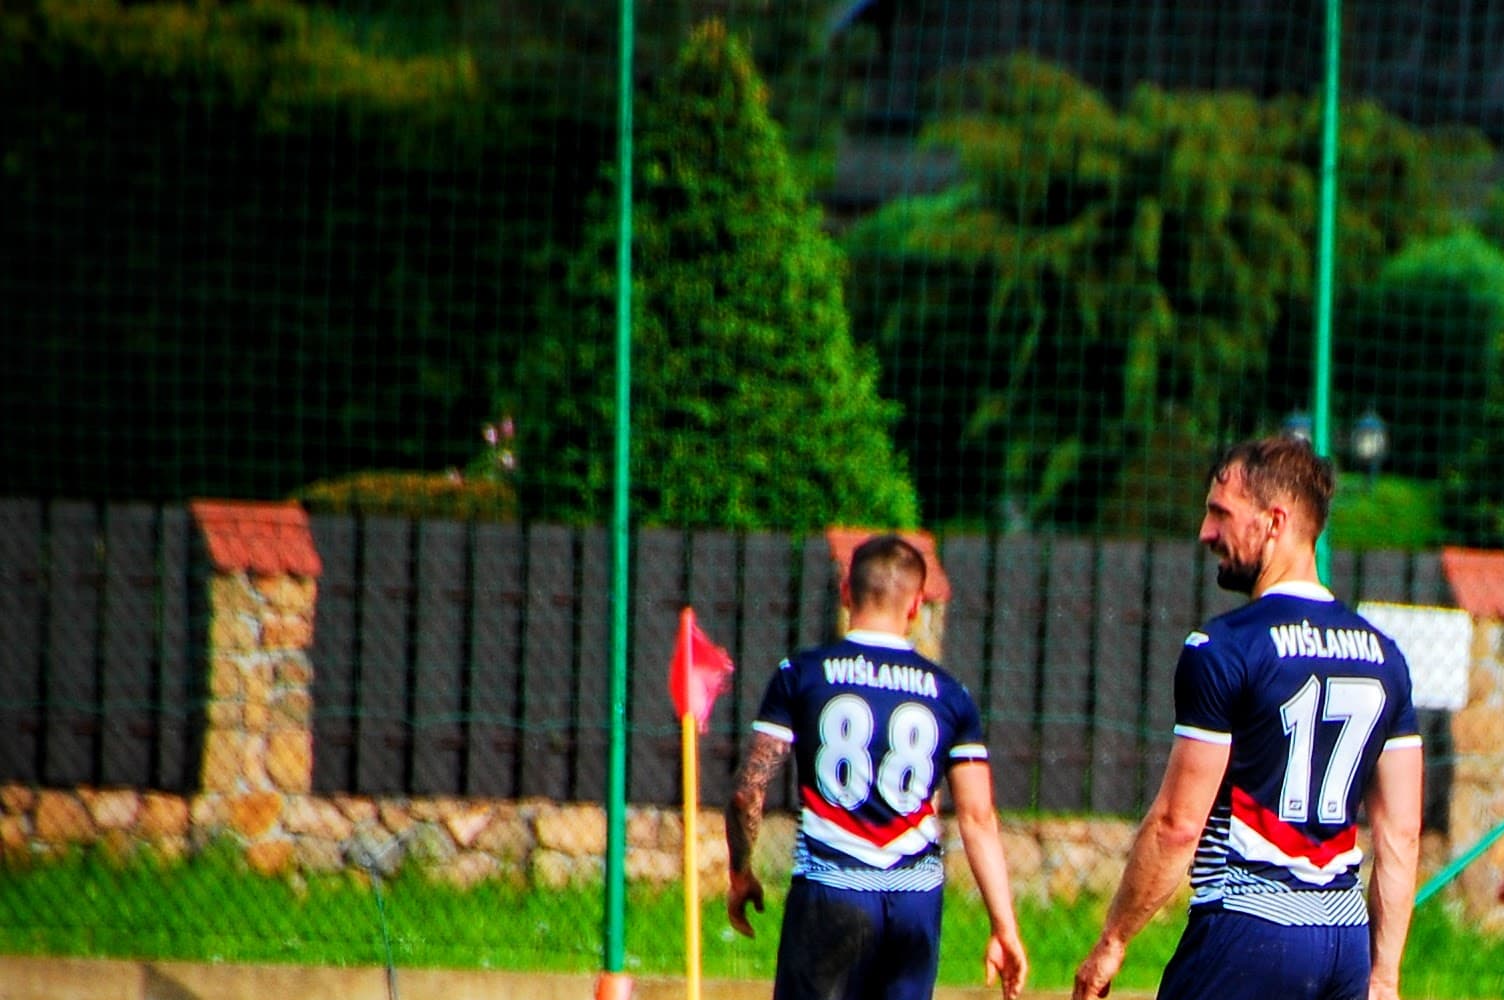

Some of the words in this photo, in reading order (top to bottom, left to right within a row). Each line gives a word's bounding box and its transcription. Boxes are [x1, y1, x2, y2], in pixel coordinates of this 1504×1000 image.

[823, 654, 939, 699] WIŚLANKA
[1269, 619, 1385, 664] WIŚLANKA
[815, 693, 939, 817] 88
[1278, 673, 1387, 824] 17
